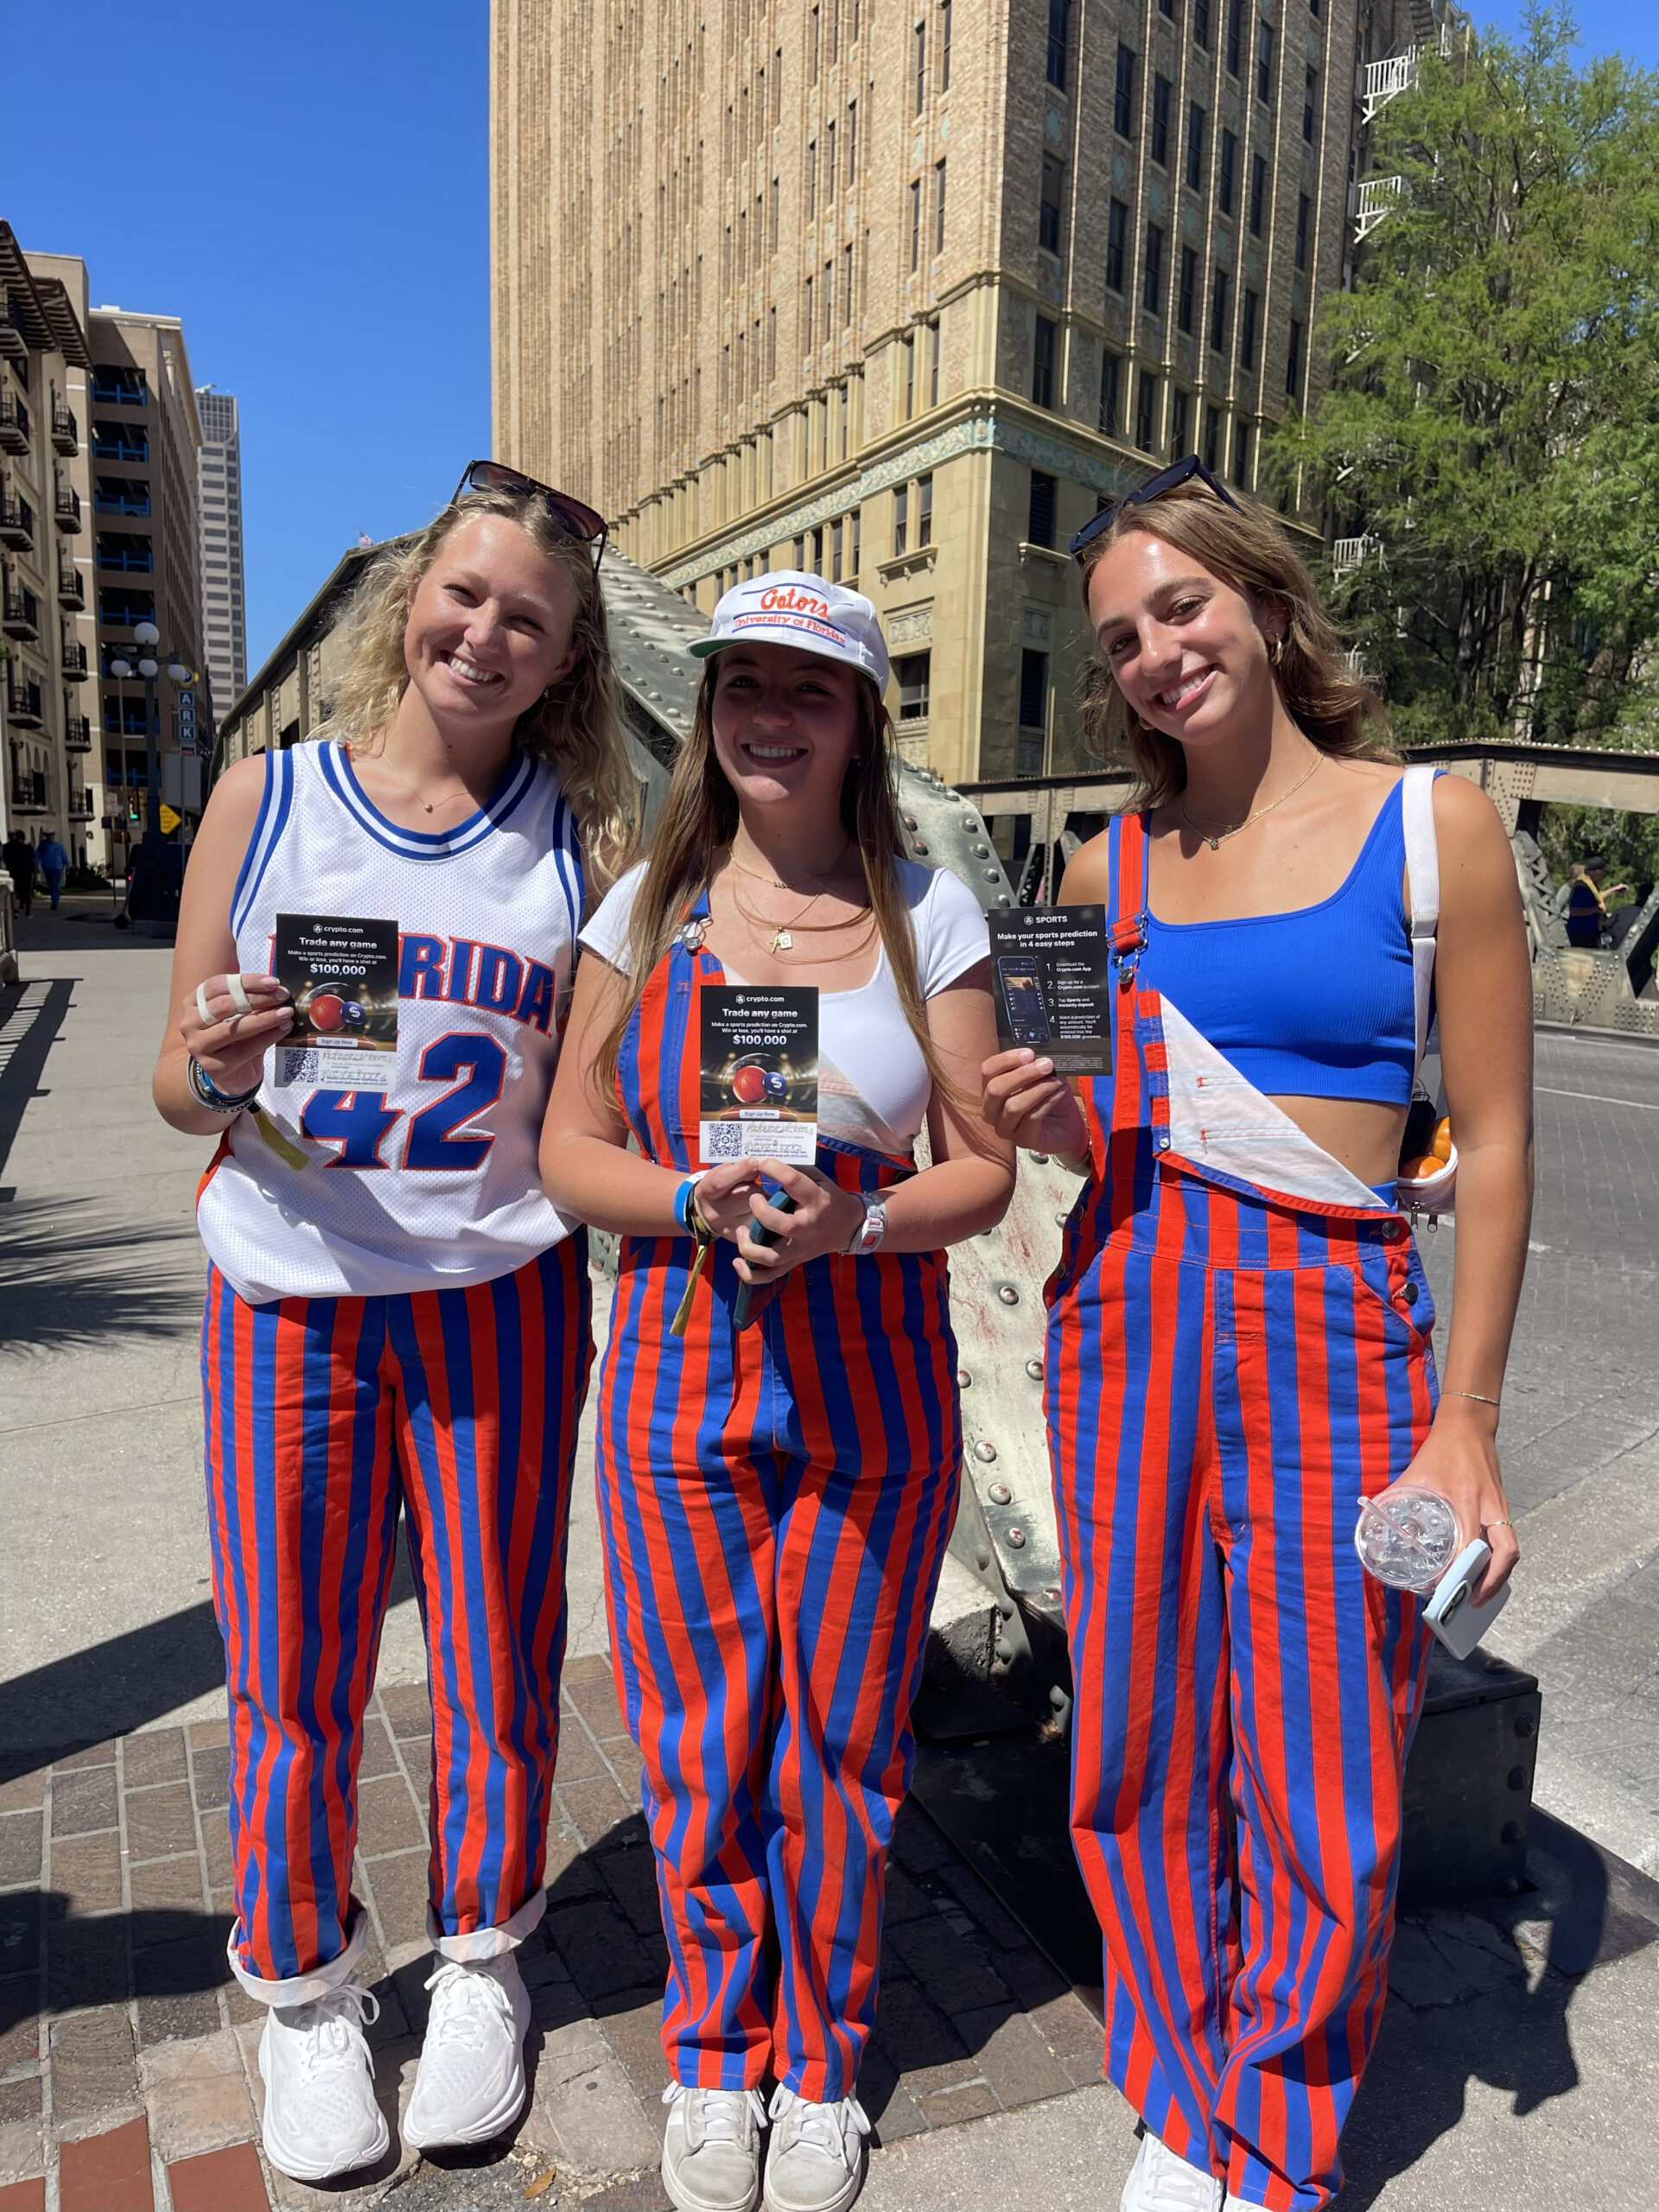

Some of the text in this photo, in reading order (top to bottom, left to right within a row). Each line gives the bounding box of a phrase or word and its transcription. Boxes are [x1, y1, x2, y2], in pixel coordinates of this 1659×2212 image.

[760, 588, 829, 618] Gators
[735, 615, 839, 639] University of Florida
[299, 937, 377, 949] Trade any game
[310, 963, 366, 976] $100,000
[1046, 963, 1052, 971] 1.
[722, 1008, 798, 1019] Trade any game
[733, 1035, 787, 1046] $100,000
[301, 1032, 507, 1170] 42
